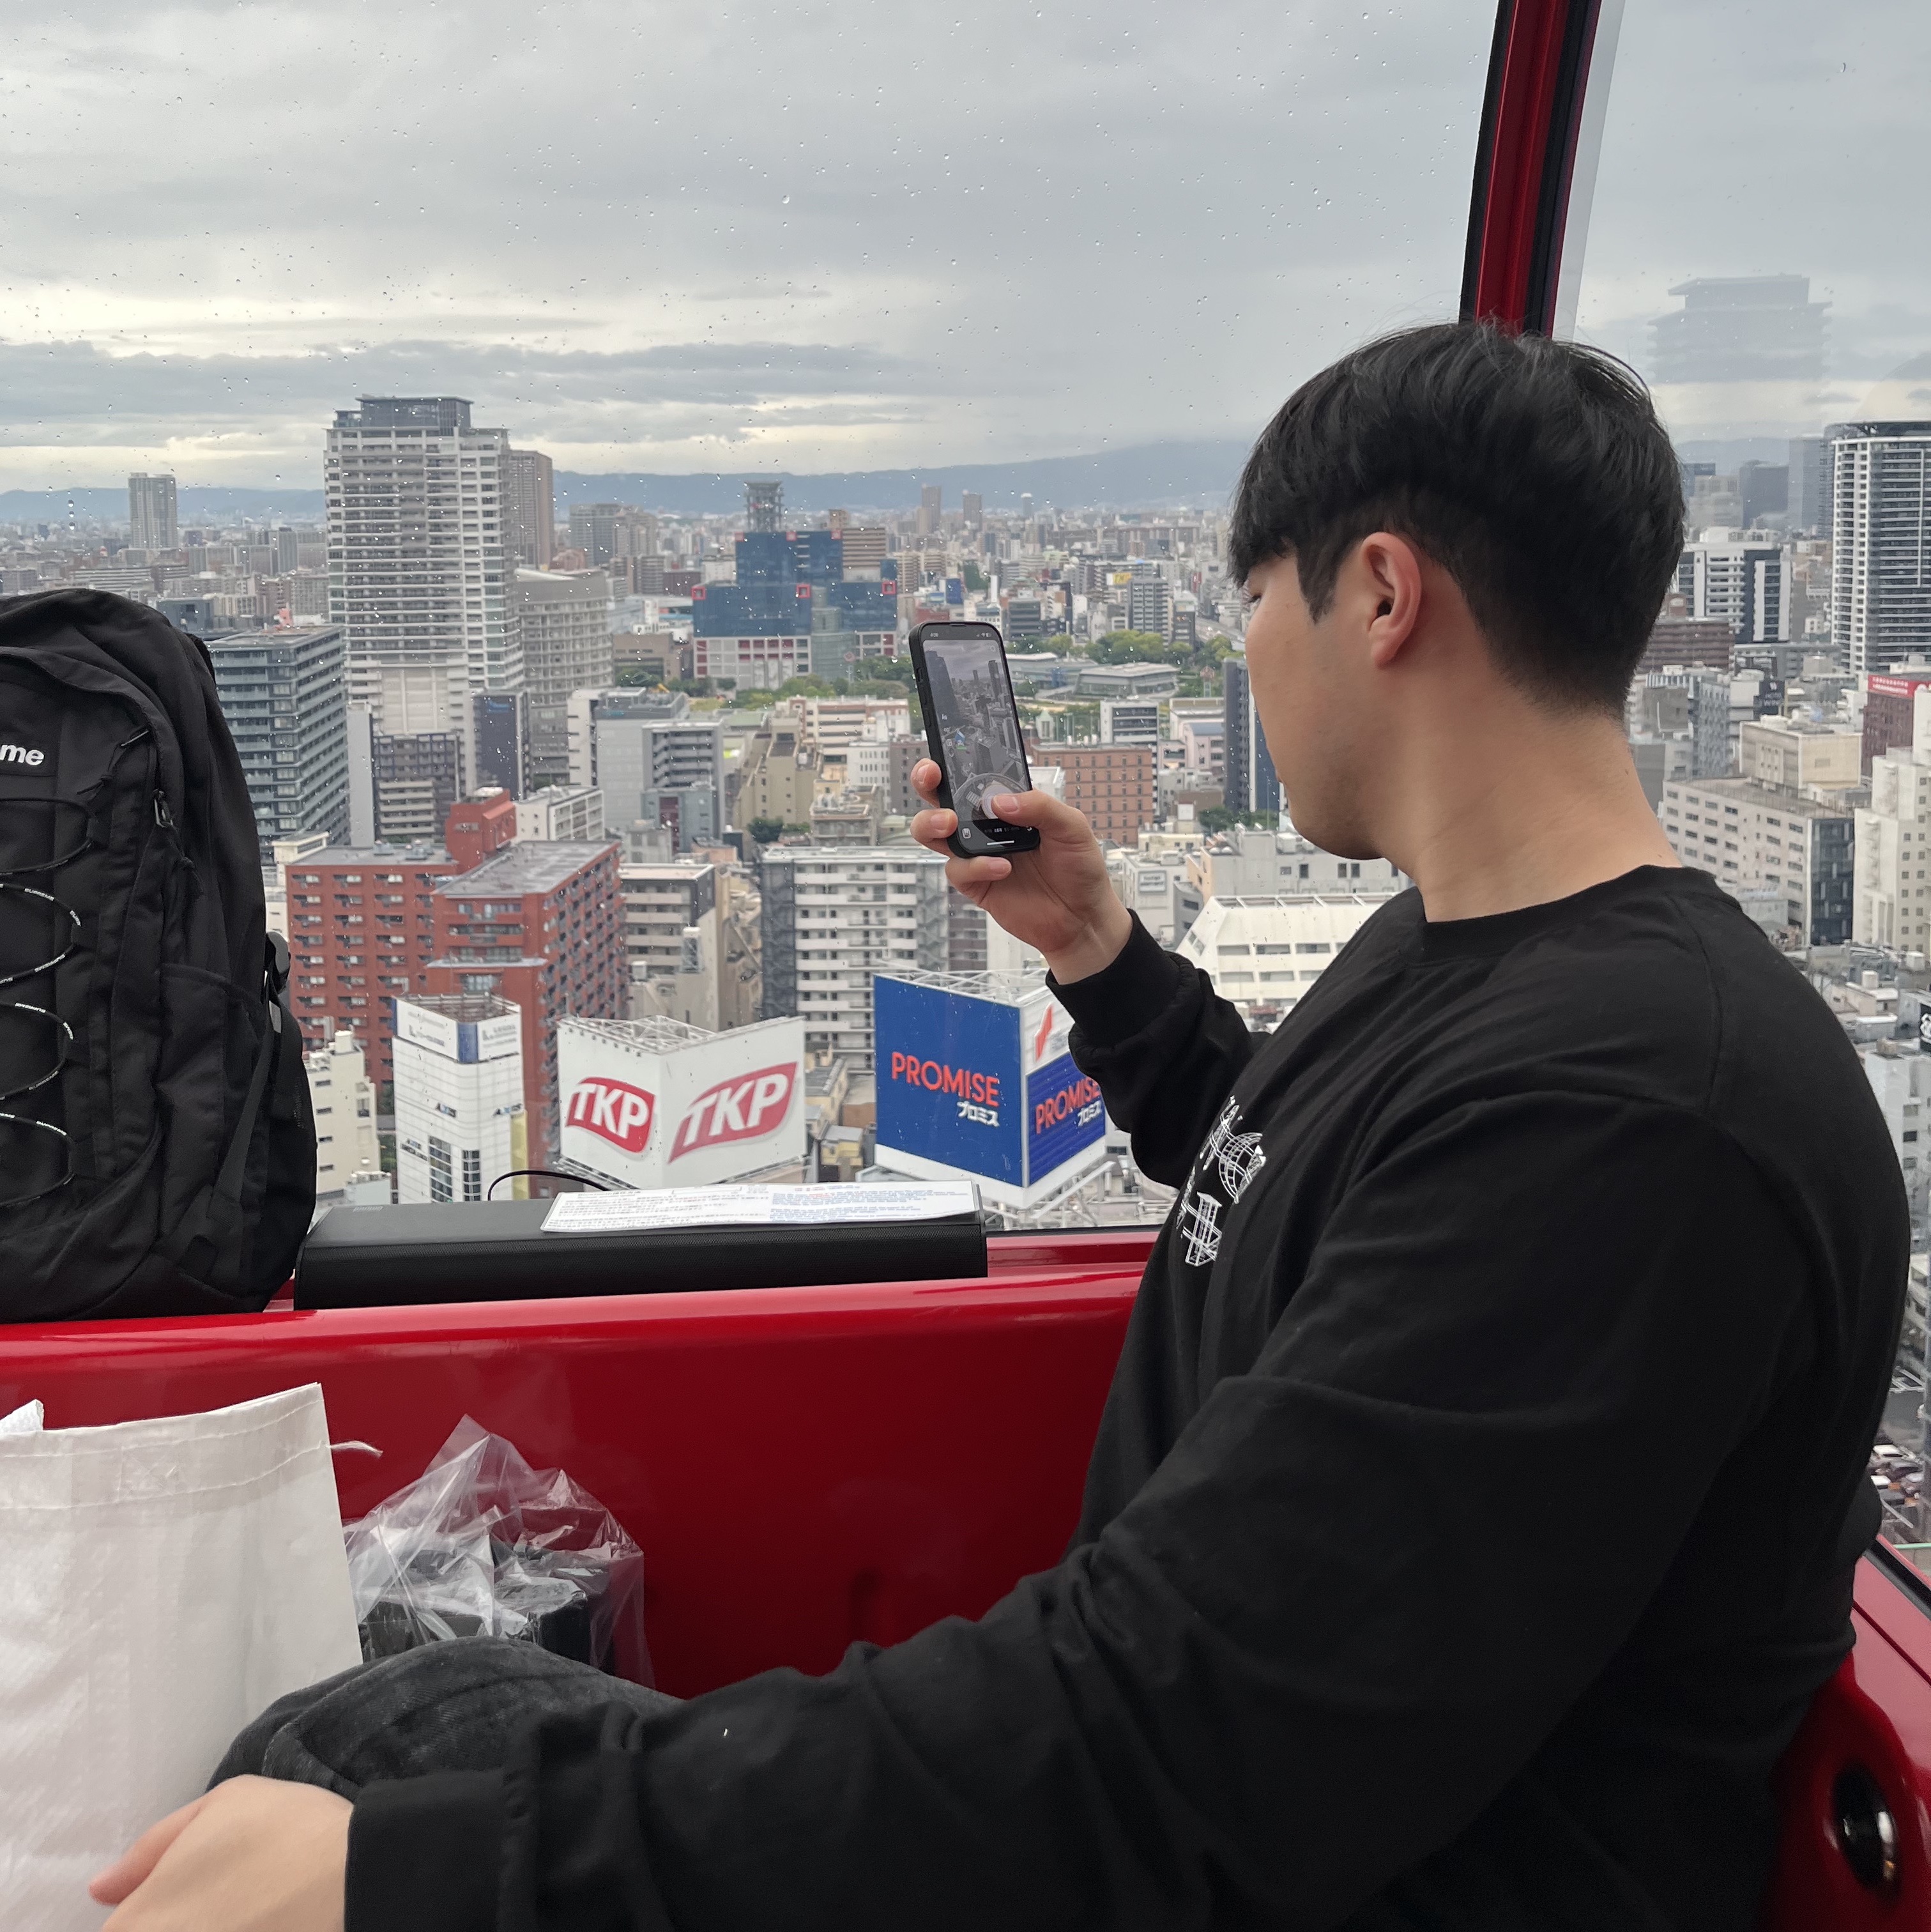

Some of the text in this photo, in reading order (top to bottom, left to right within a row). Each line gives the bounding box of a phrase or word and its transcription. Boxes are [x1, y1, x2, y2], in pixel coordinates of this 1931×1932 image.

[0, 744, 45, 765] me
[892, 1052, 1000, 1107] PROMISE
[1035, 1076, 1101, 1135] PROMISE
[573, 1083, 650, 1138] TKP
[683, 1073, 789, 1147] TKP
[957, 1101, 1000, 1127] プロミス
[1077, 1100, 1103, 1128] プロミス
